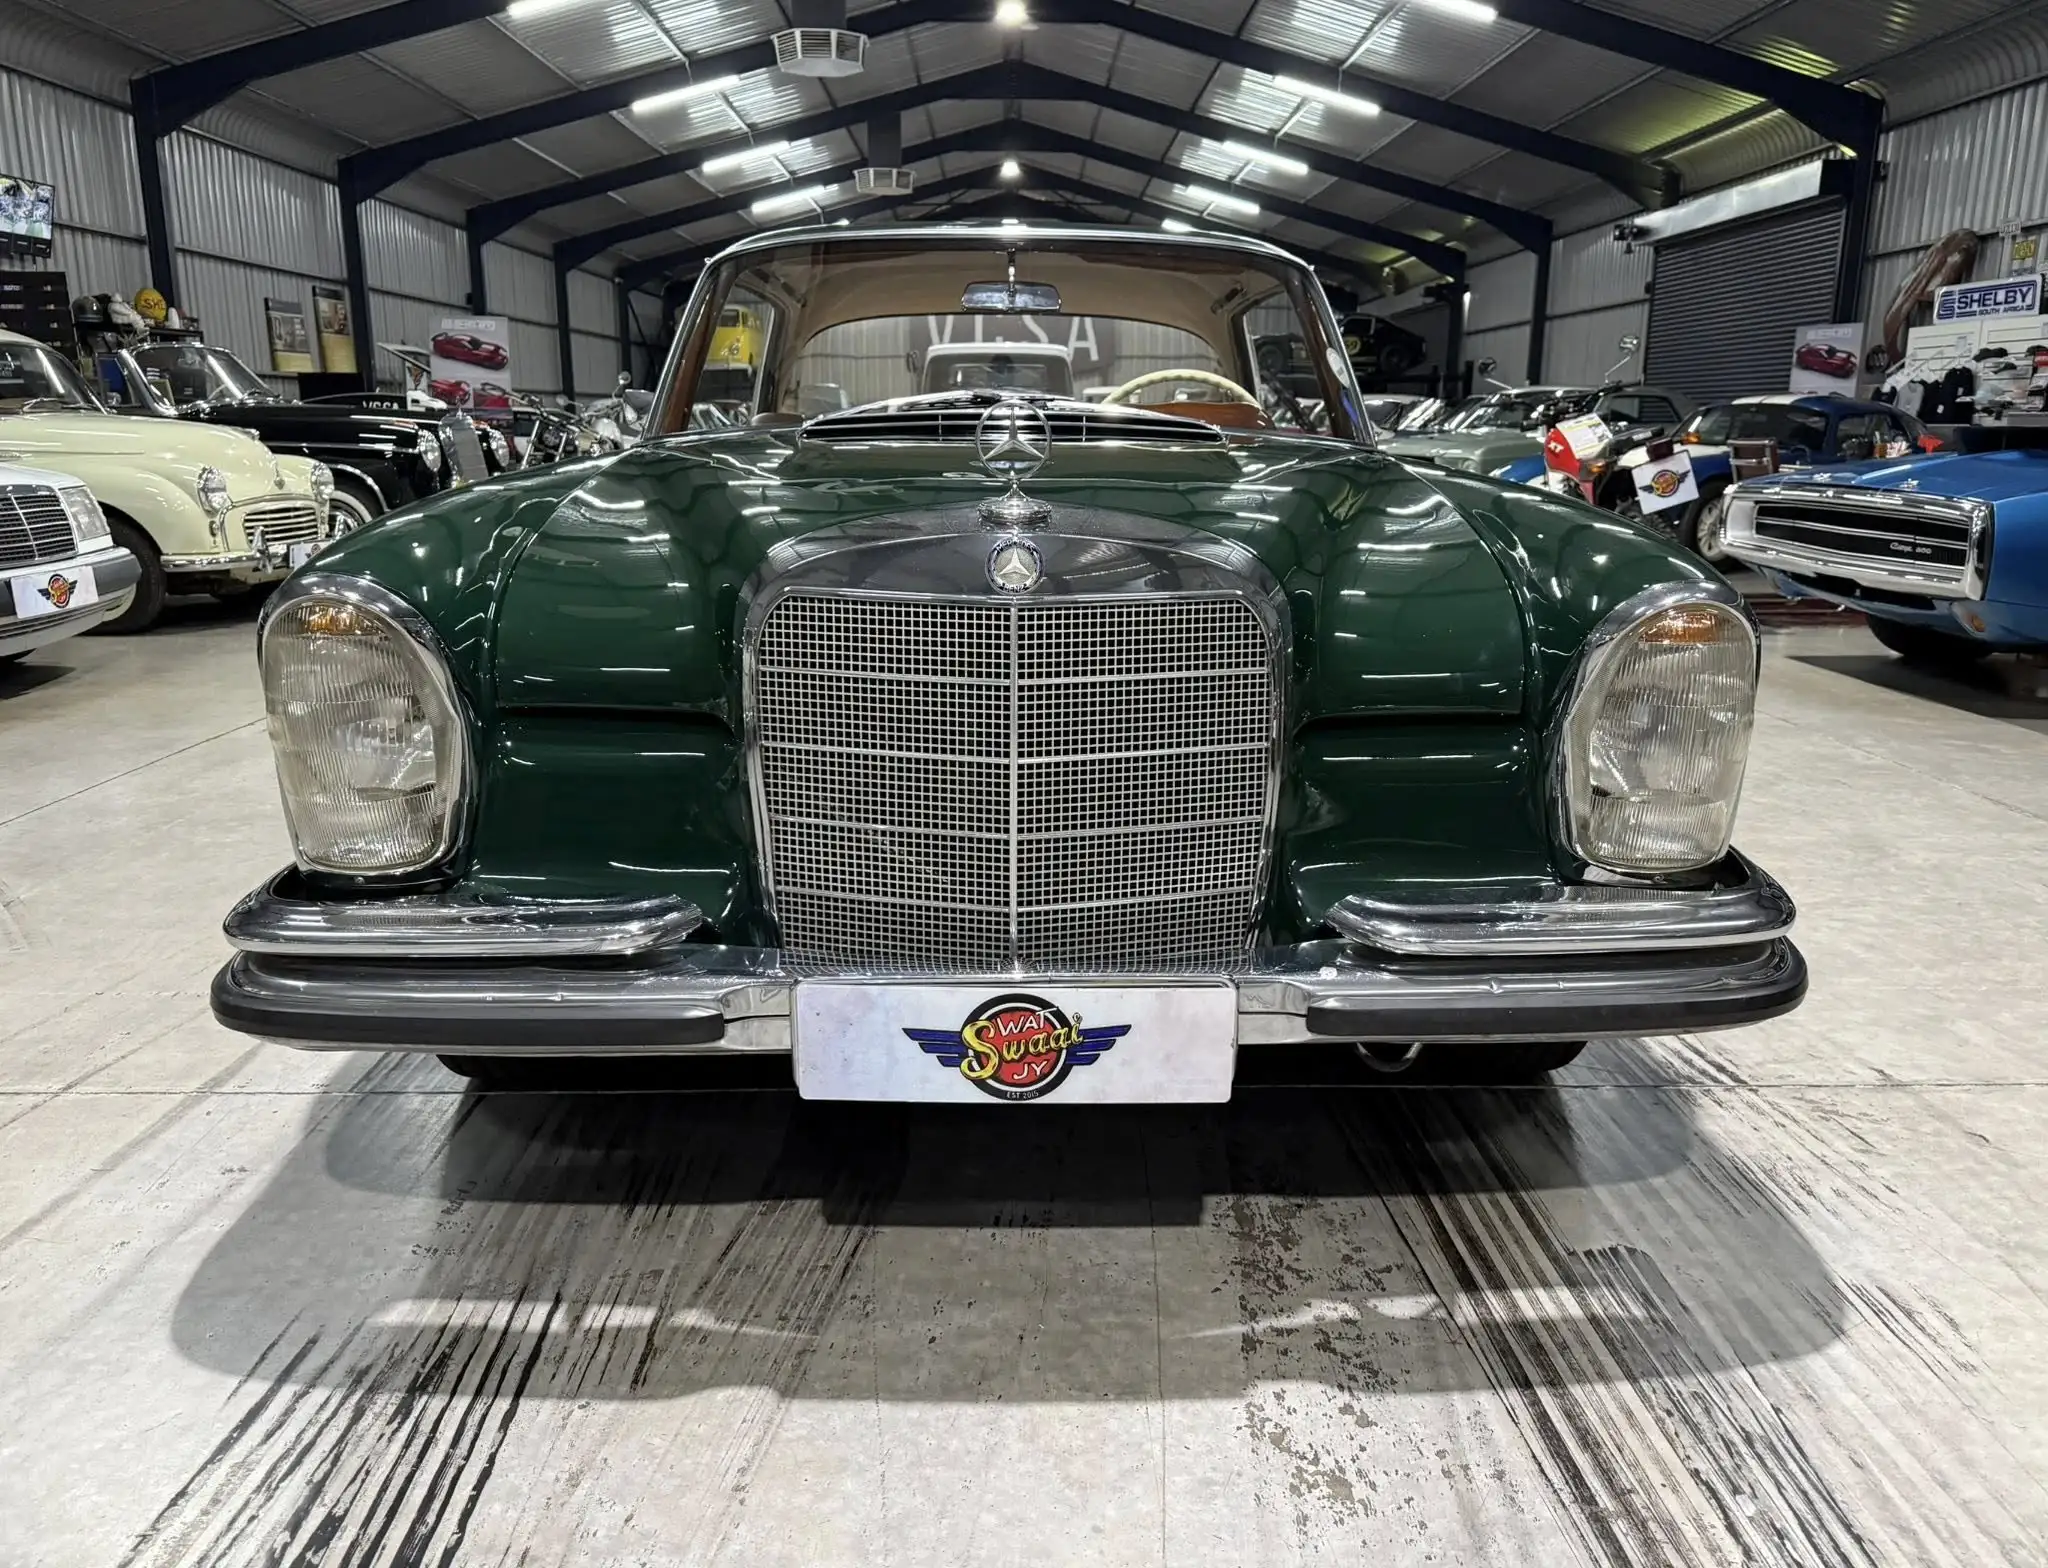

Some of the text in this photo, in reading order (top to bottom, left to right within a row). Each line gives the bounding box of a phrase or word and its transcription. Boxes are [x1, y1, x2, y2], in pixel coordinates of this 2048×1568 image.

[1957, 287, 2032, 310] SHELBY
[1978, 305, 2025, 317] SOUTH AFRICA
[996, 1007, 1058, 1037] WAT
[960, 1012, 1084, 1080] Swaai
[1012, 1060, 1048, 1079] JY
[1006, 1090, 1039, 1099] EST 2015
